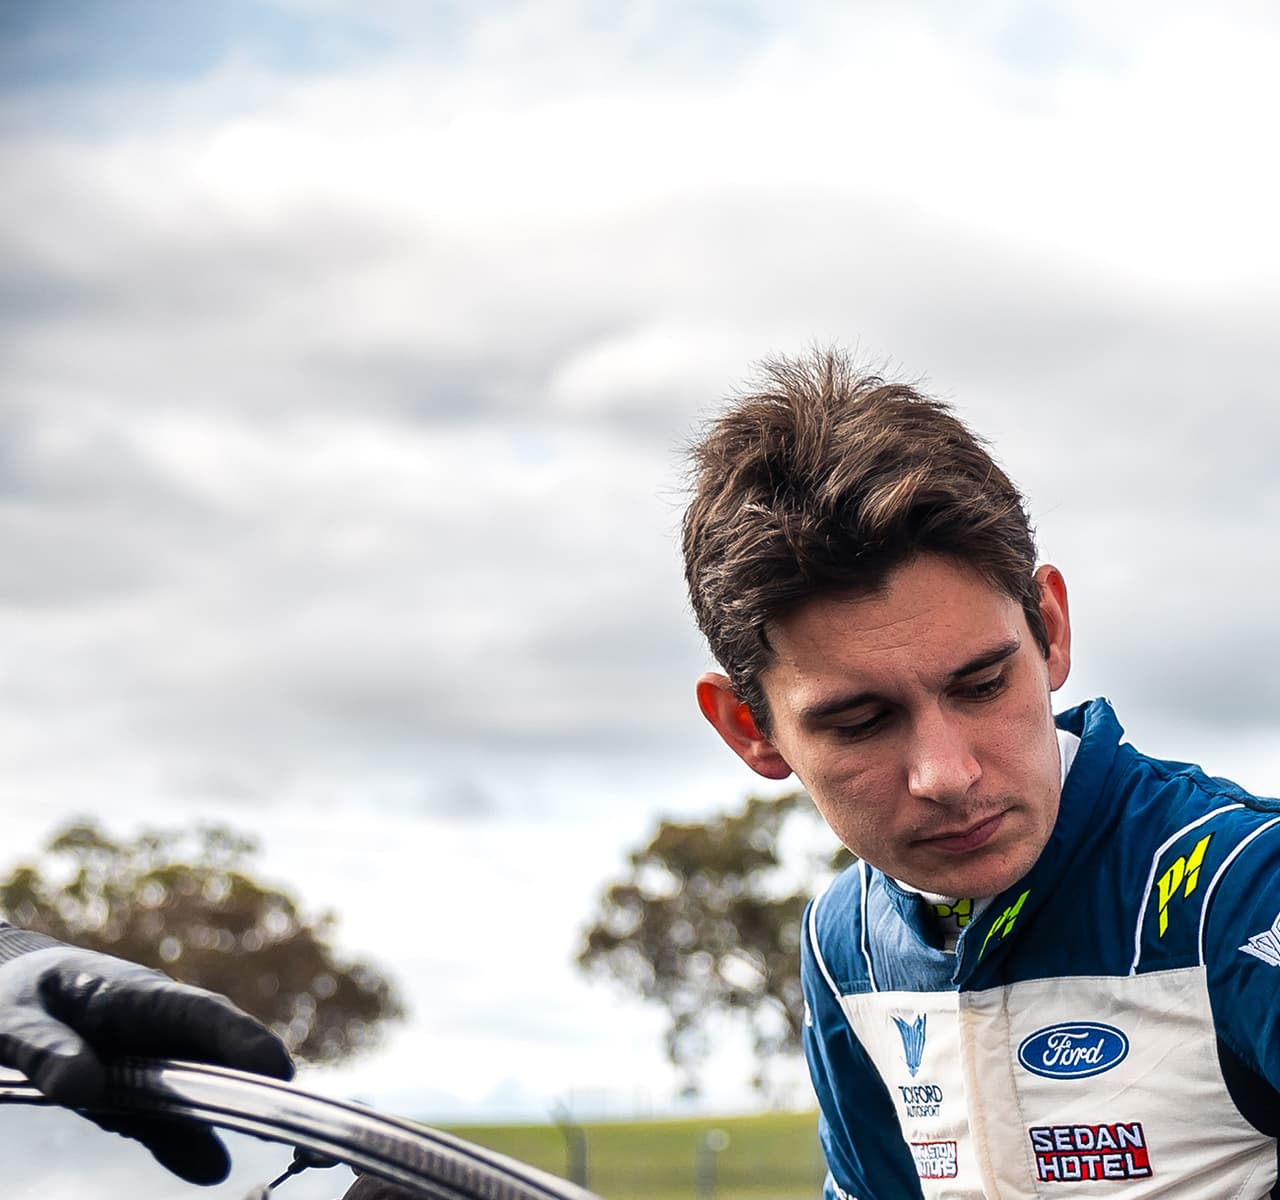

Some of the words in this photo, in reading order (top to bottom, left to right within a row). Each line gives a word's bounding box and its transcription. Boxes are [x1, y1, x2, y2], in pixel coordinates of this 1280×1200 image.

[1042, 1031, 1105, 1067] Ford
[1032, 1125, 1143, 1151] SEDAN
[1038, 1152, 1148, 1178] HOTEL
